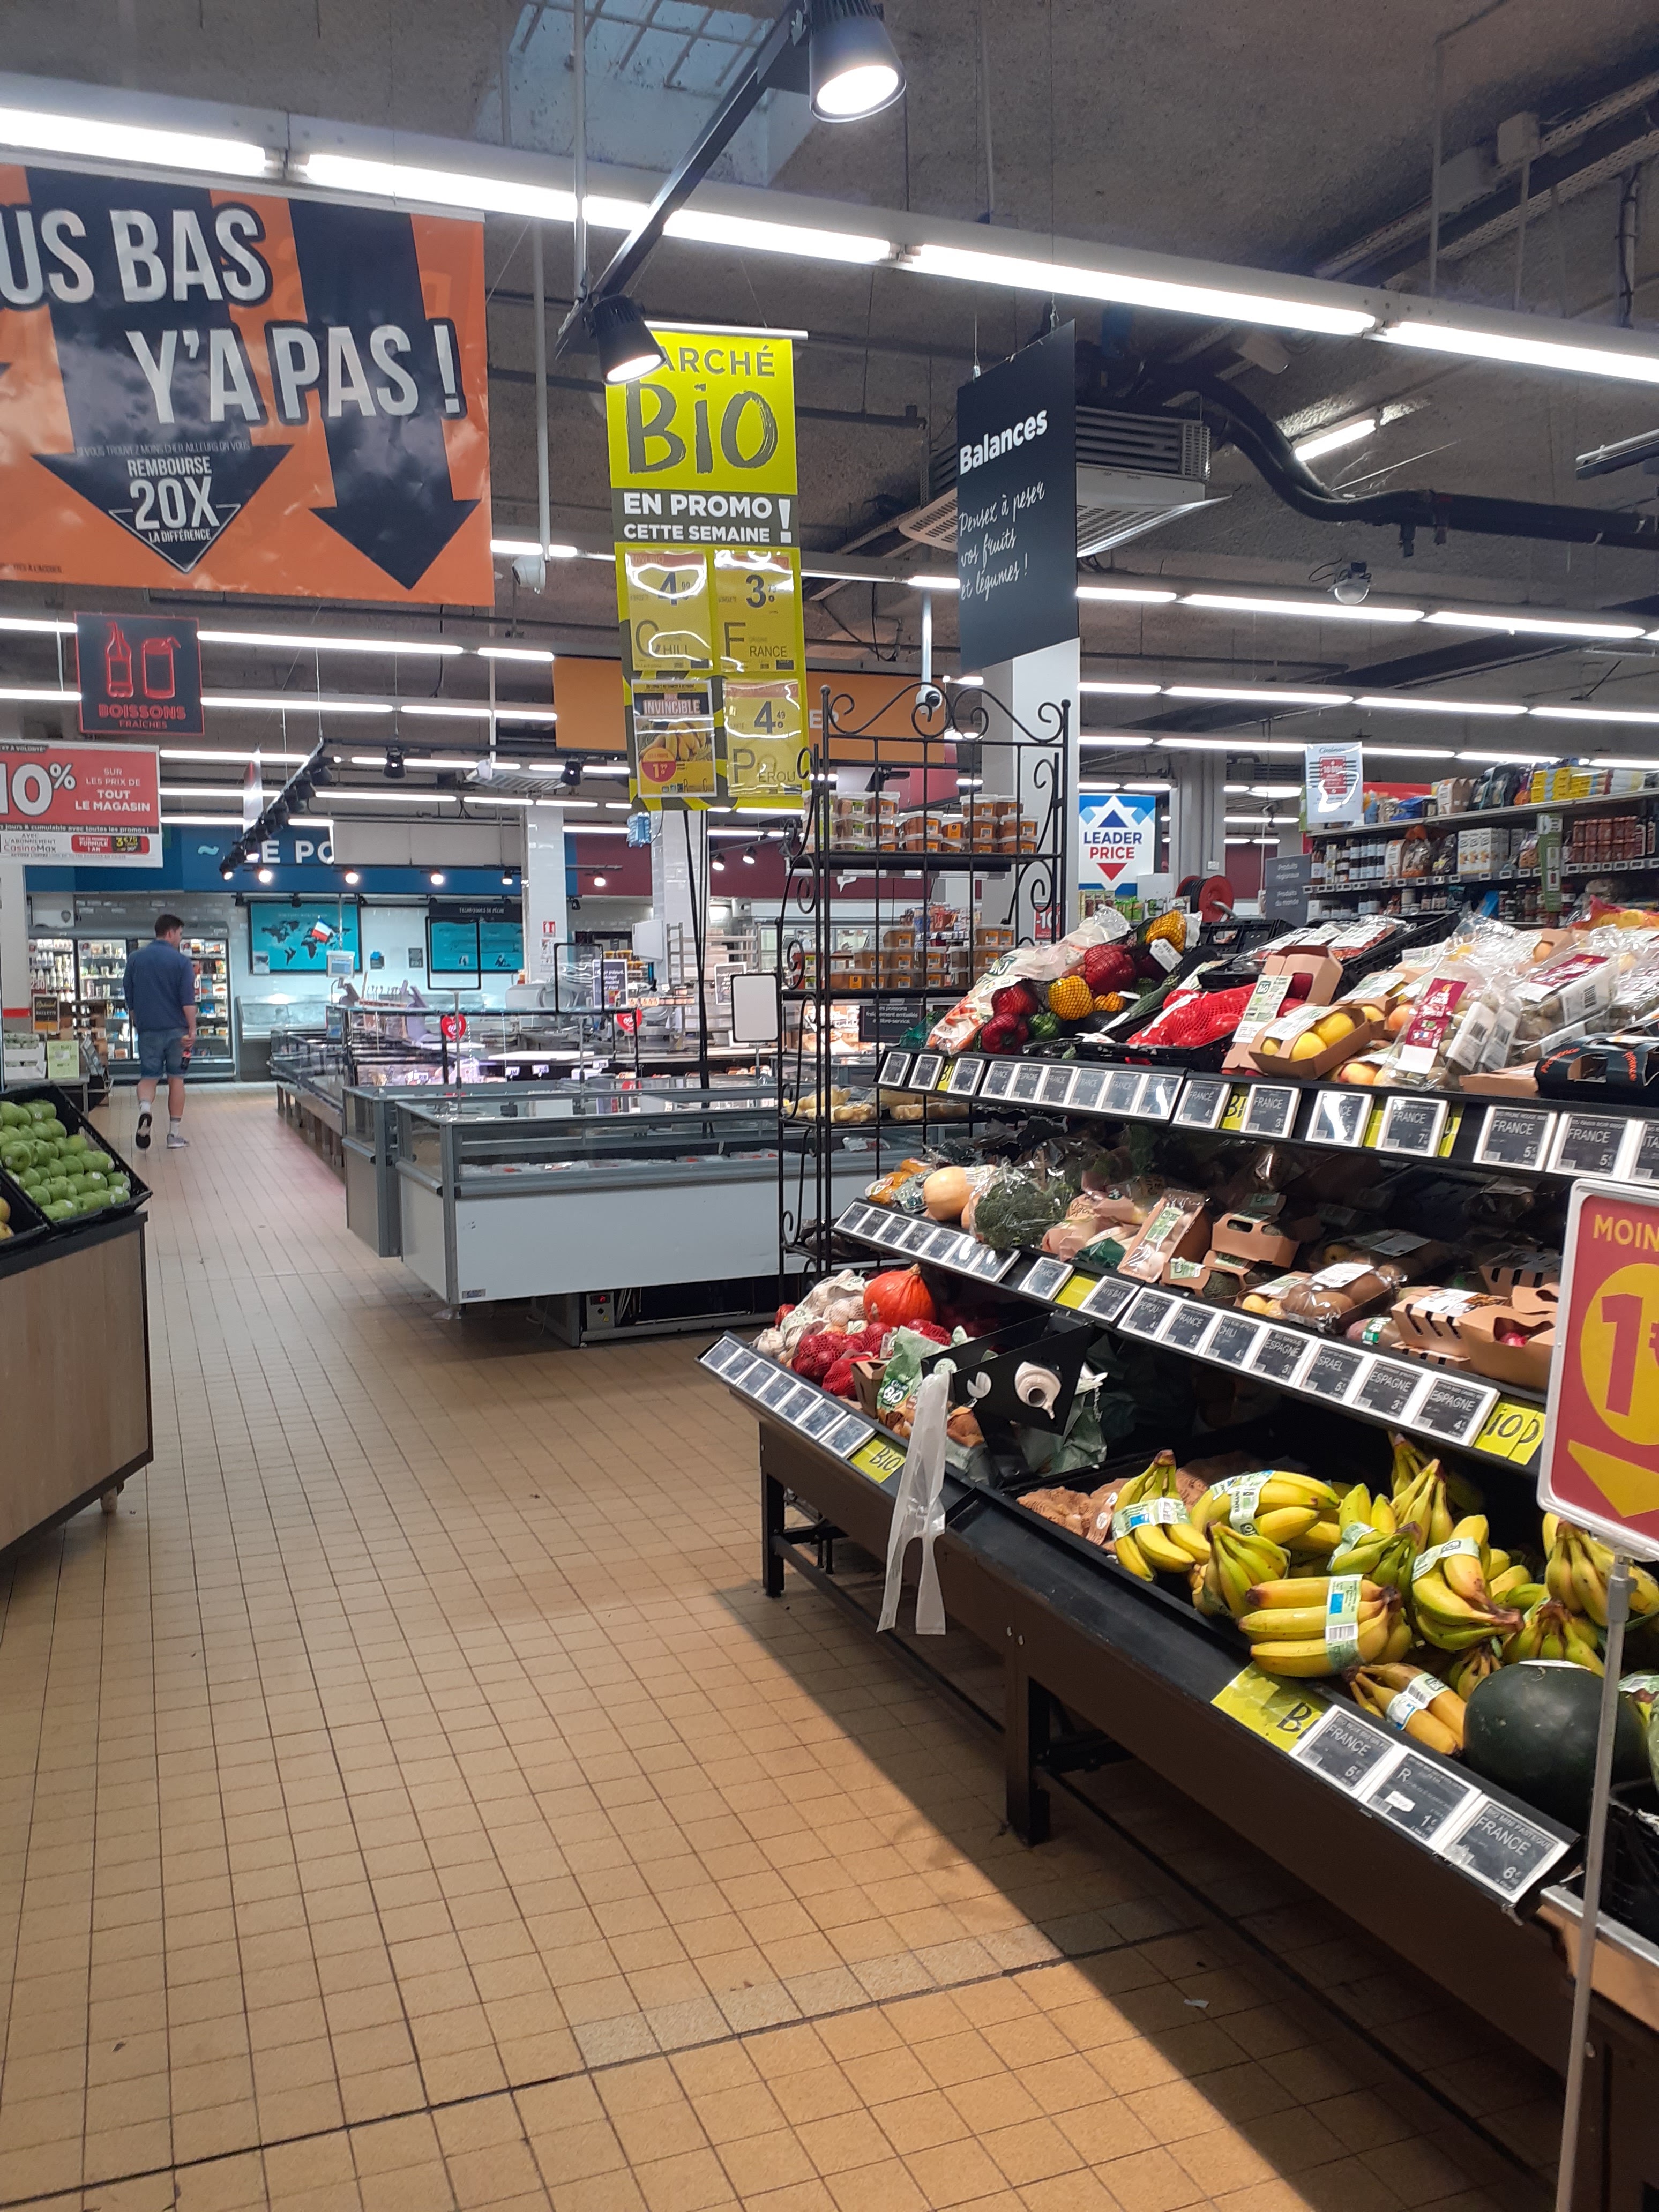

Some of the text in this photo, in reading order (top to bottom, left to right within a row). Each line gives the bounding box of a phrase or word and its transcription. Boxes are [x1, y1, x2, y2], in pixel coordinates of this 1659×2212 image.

[111, 208, 267, 302] BAS
[660, 345, 776, 377] ARCHÉ
[125, 324, 462, 424] Y'A PAS !
[230, 440, 251, 451] VOUS
[959, 409, 1048, 476] Balances
[127, 455, 212, 477] REMBOURSE
[130, 476, 220, 530] 20X
[623, 492, 662, 515] EN
[671, 494, 772, 519] PROMO
[959, 481, 1045, 536] Pensez à peser
[148, 528, 212, 543] LA DIFFÉRENCE
[623, 524, 771, 543] CETTE SEMAINE
[960, 527, 1017, 570] vos fruits
[961, 580, 973, 601] et
[975, 560, 1020, 602] légumes
[745, 574, 766, 608] 3
[98, 703, 186, 720] BOISSONS
[643, 699, 701, 715] INVINCIBLE
[776, 711, 786, 719] 49
[754, 700, 776, 734] 4
[103, 767, 123, 776] SUR
[85, 778, 141, 787] LES PRIX DE
[96, 789, 131, 801] TOUT
[74, 801, 151, 812] LE MAGASIN
[31, 824, 67, 832] cumulable
[1083, 831, 1142, 845] LEADER
[3, 845, 57, 853] CasinoMax
[1089, 847, 1135, 860] PRICE
[939, 1064, 955, 1083] BI
[1018, 1072, 1039, 1081] ESPAGNE
[1048, 1074, 1067, 1085] FRANCE
[1188, 1090, 1214, 1103] FRANCE
[1253, 1096, 1284, 1110] FRANCE
[1224, 1093, 1247, 1119] BI
[1393, 1110, 1428, 1125] FRANCE
[1491, 1119, 1536, 1136] FRANCE
[1567, 1127, 1612, 1145] FRANCE
[1100, 1286, 1126, 1300] PAYS BAS
[1175, 1313, 1204, 1328] FRANCE
[1218, 1325, 1238, 1338] CHILI
[1264, 1339, 1301, 1358] ESPAGNE
[1369, 1371, 1413, 1393] ESPAGNE
[1429, 1389, 1476, 1412] ESPAGNE
[869, 1446, 902, 1472] BIO
[1325, 1724, 1372, 1758] FRANCE
[1474, 1815, 1533, 1857] FRANCE
